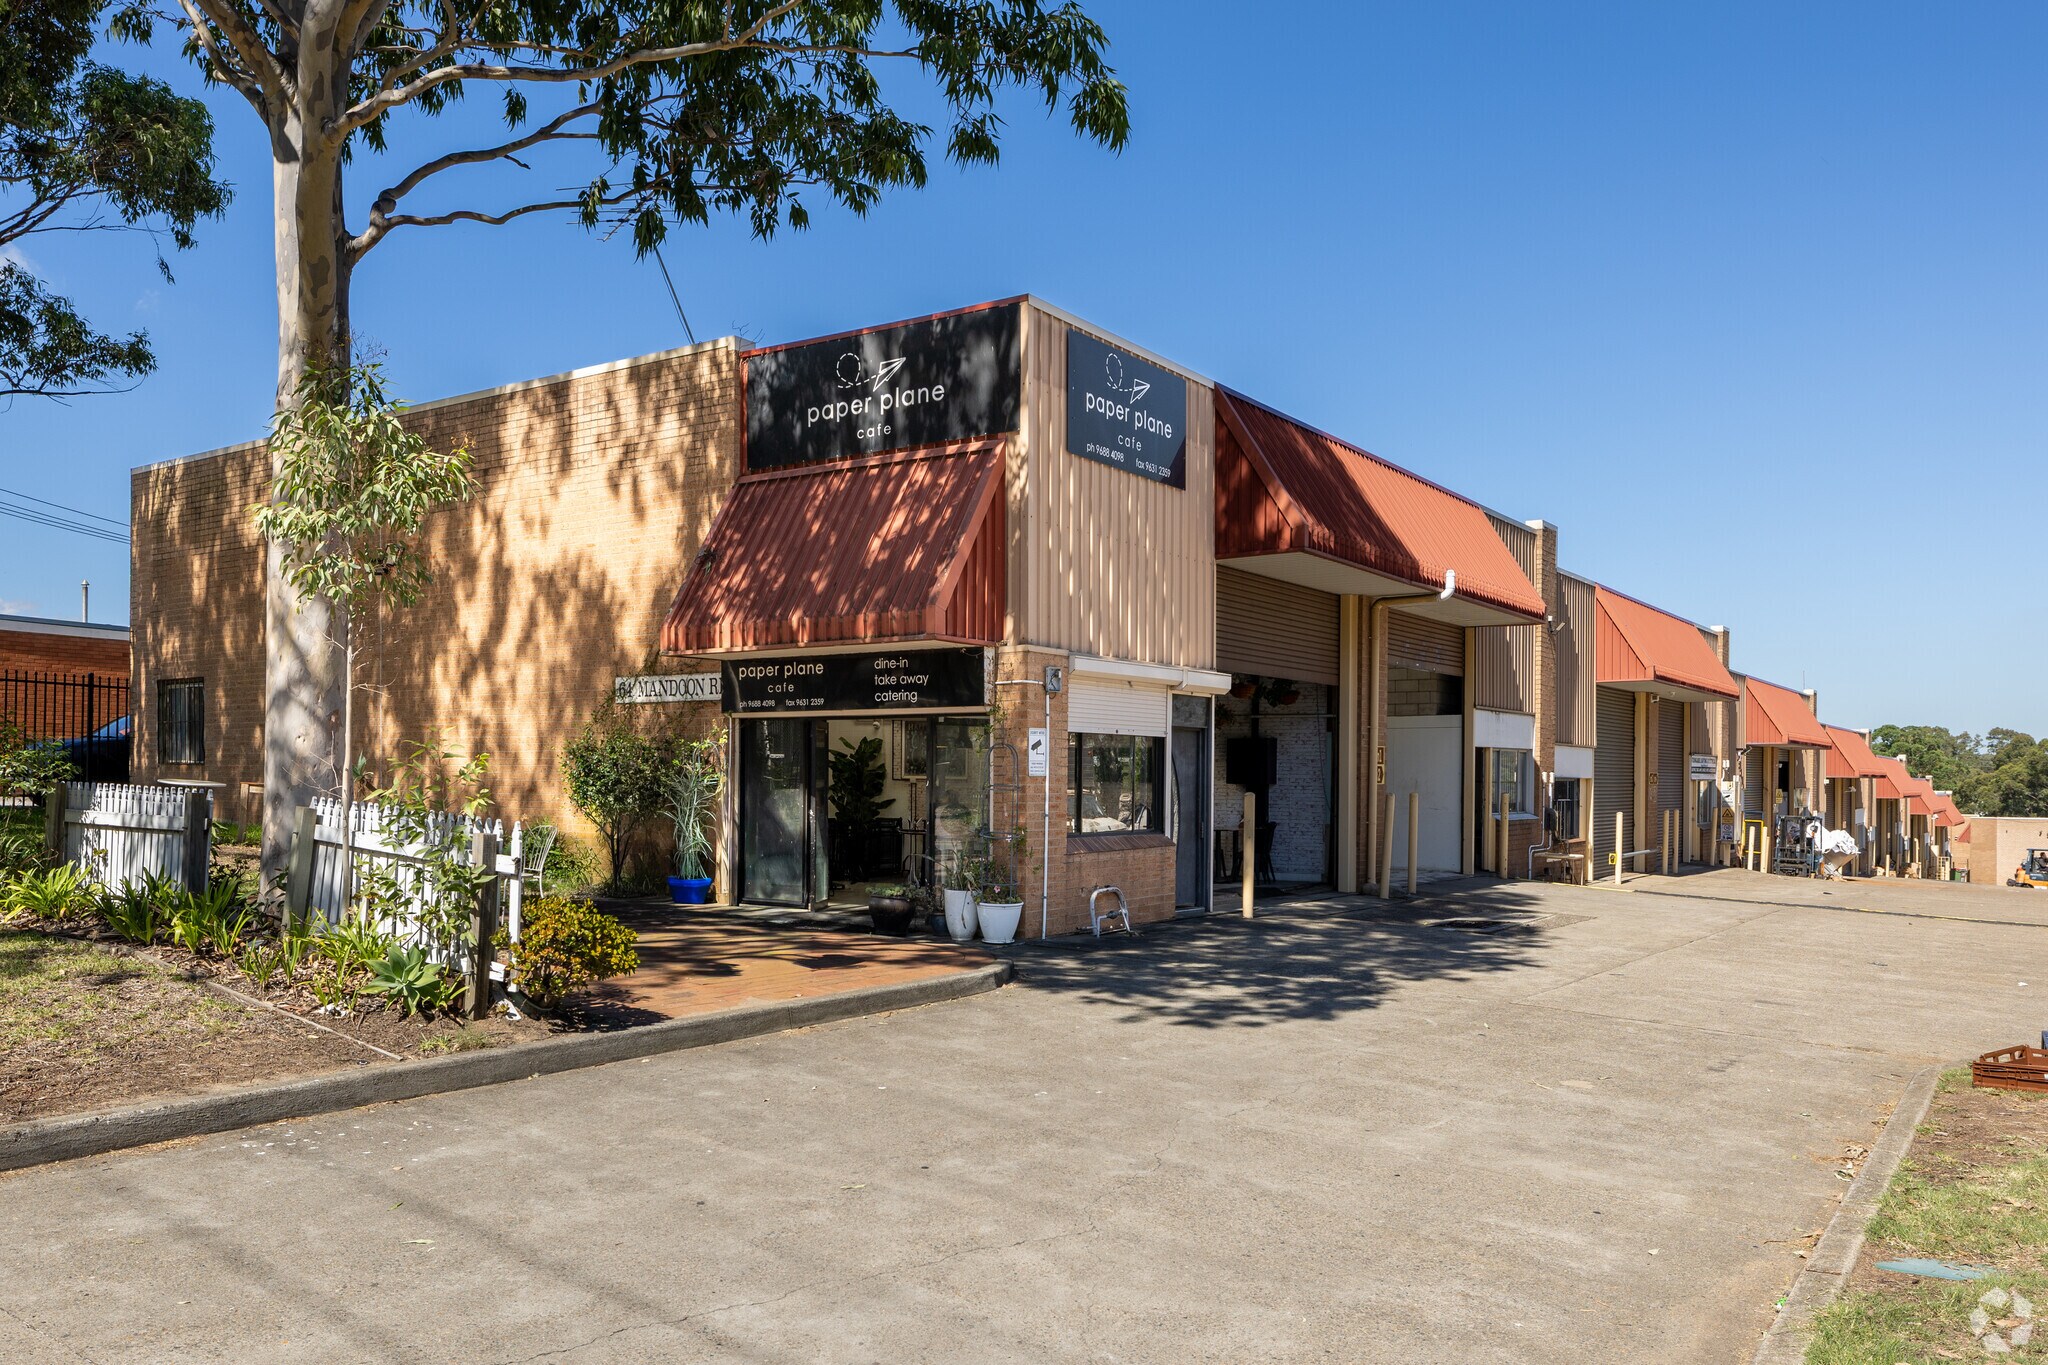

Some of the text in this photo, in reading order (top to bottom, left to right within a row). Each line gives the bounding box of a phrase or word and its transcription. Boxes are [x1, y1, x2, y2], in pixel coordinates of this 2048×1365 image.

[807, 384, 945, 427] paper plane
[1086, 392, 1172, 439] paper plane
[856, 423, 892, 439] cafe
[1117, 434, 1142, 452] cafe
[1086, 442, 1125, 463] ph 9688 4098
[1135, 457, 1171, 478] fax 9631 2359
[738, 661, 824, 680] paper plane
[874, 656, 909, 669] dine-in
[637, 678, 705, 698] MANDOON
[767, 682, 795, 693] cafe
[874, 673, 929, 686] take away
[739, 699, 776, 708] ph 9688 4098
[795, 698, 809, 706] 9631
[810, 697, 825, 706] 2359
[874, 689, 918, 703] catering
